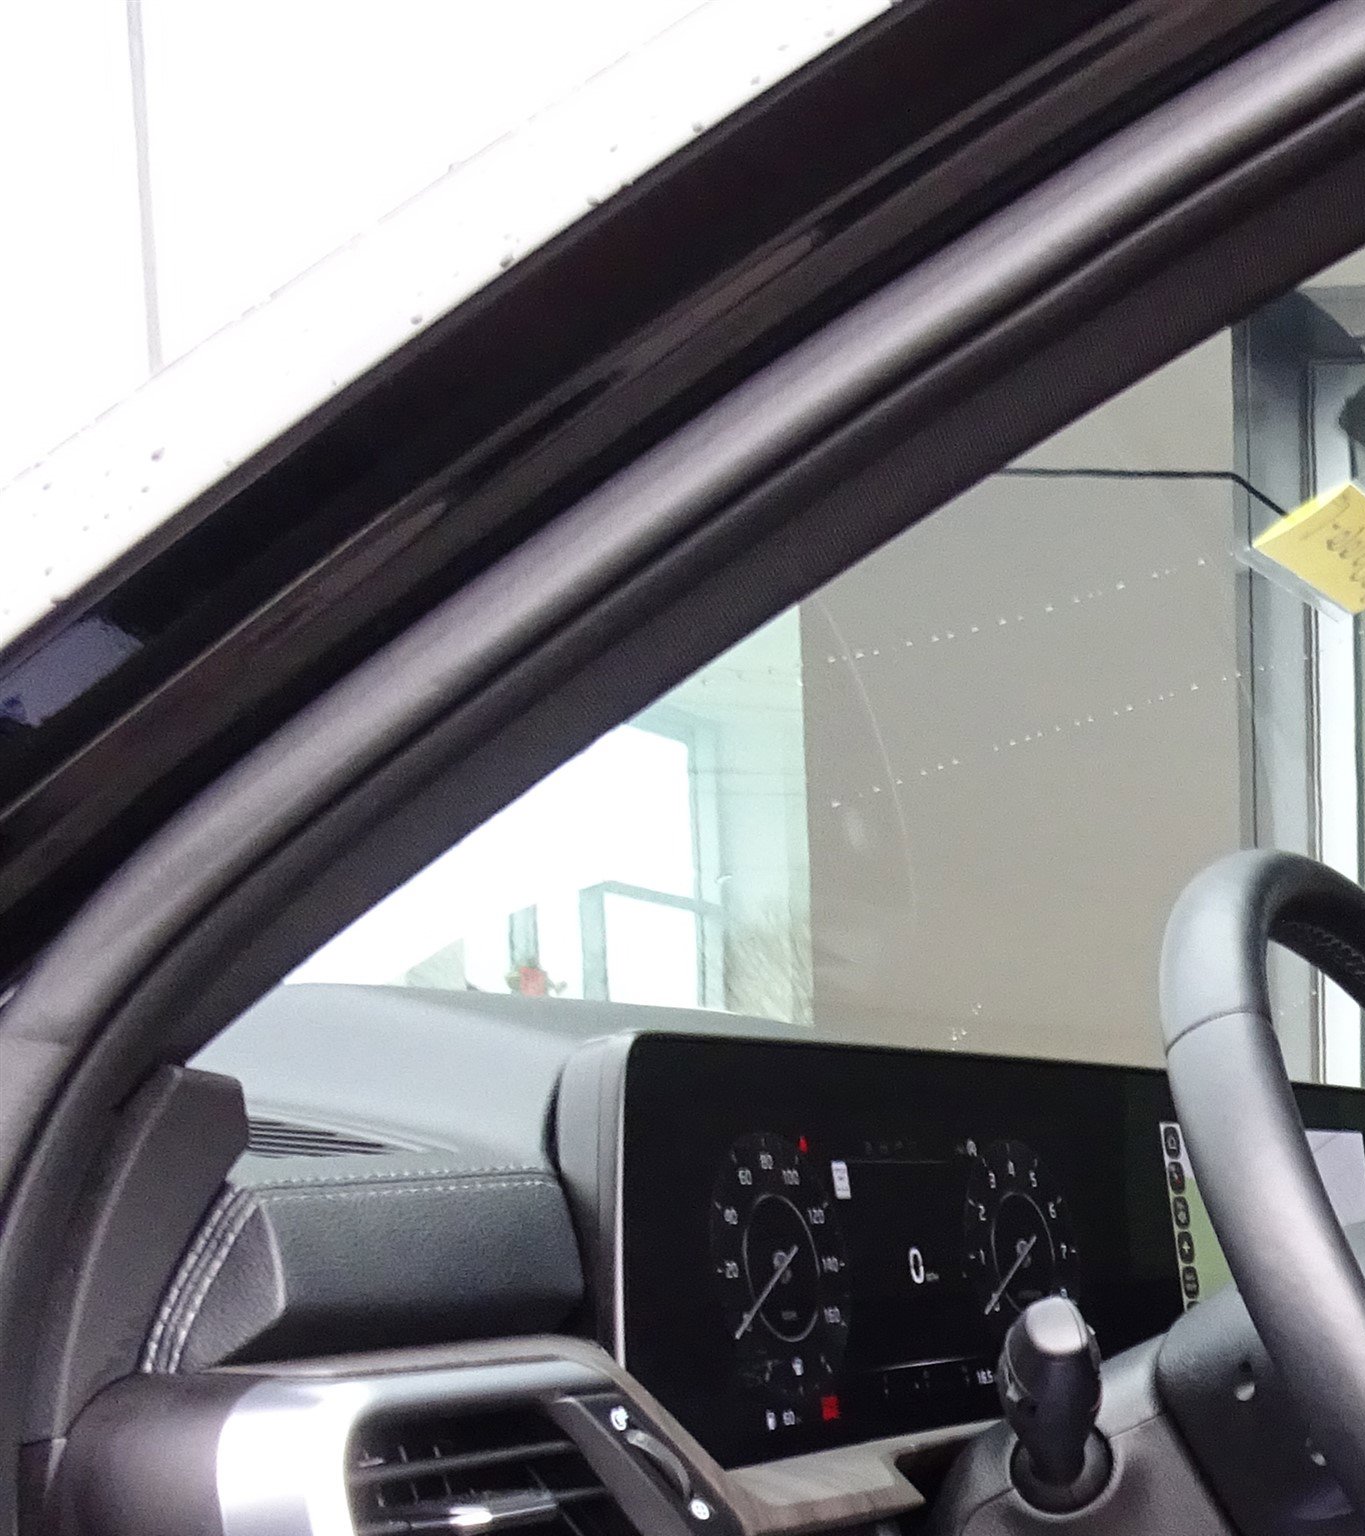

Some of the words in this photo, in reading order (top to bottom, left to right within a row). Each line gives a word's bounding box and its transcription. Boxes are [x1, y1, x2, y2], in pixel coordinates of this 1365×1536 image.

[988, 1170, 997, 1189] 3
[977, 1203, 987, 1222] 2
[1048, 1201, 1057, 1219] 6
[1060, 1242, 1068, 1260] 7
[908, 1247, 925, 1285] 0
